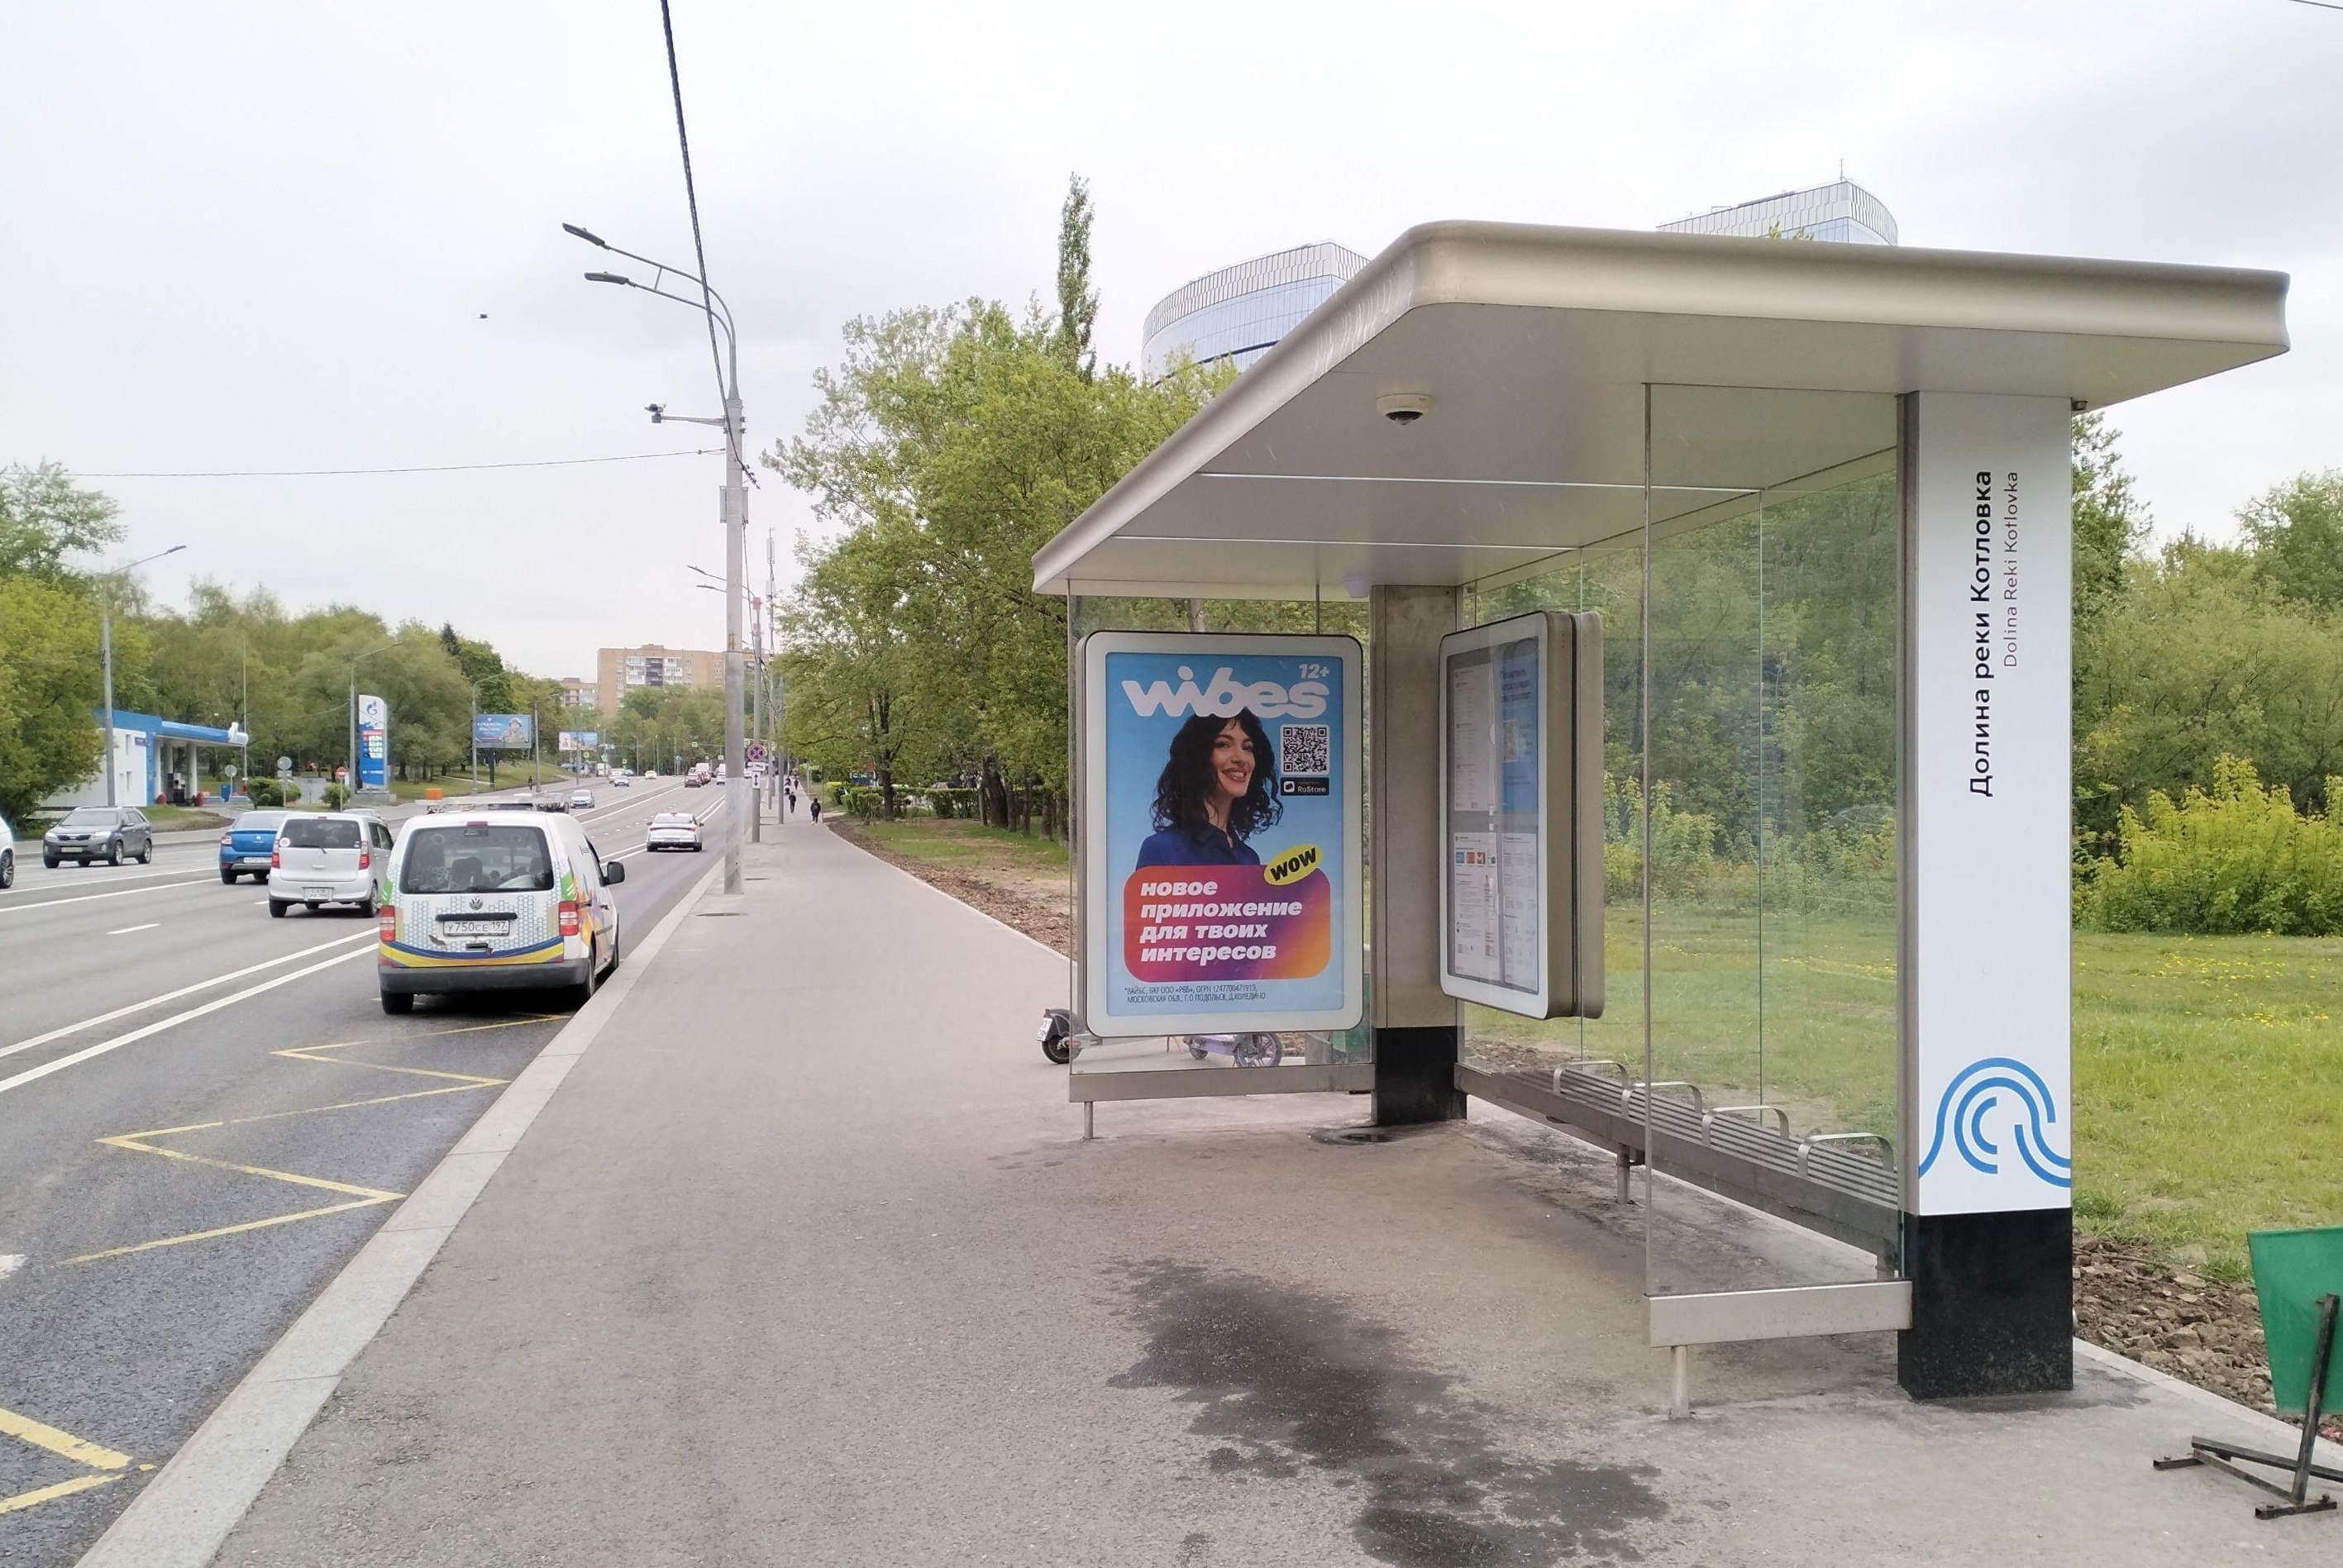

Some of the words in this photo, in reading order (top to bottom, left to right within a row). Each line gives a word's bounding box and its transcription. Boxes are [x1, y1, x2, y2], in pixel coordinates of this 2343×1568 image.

[2003, 471, 2019, 553] Kotlovka
[1970, 470, 1992, 603] Котловка
[2003, 559, 2017, 601] Reki
[1974, 612, 1994, 679] реки
[2003, 606, 2018, 668] Dolina
[1121, 665, 1330, 719] wibes
[1299, 664, 1330, 679] 12+
[1969, 689, 1993, 798] Долина
[1269, 846, 1317, 882] WOW
[1140, 881, 1218, 897] новое
[1139, 925, 1189, 944] для
[1195, 923, 1268, 939] твоих
[1140, 901, 1303, 924] приложение
[1140, 945, 1277, 966] интересов
